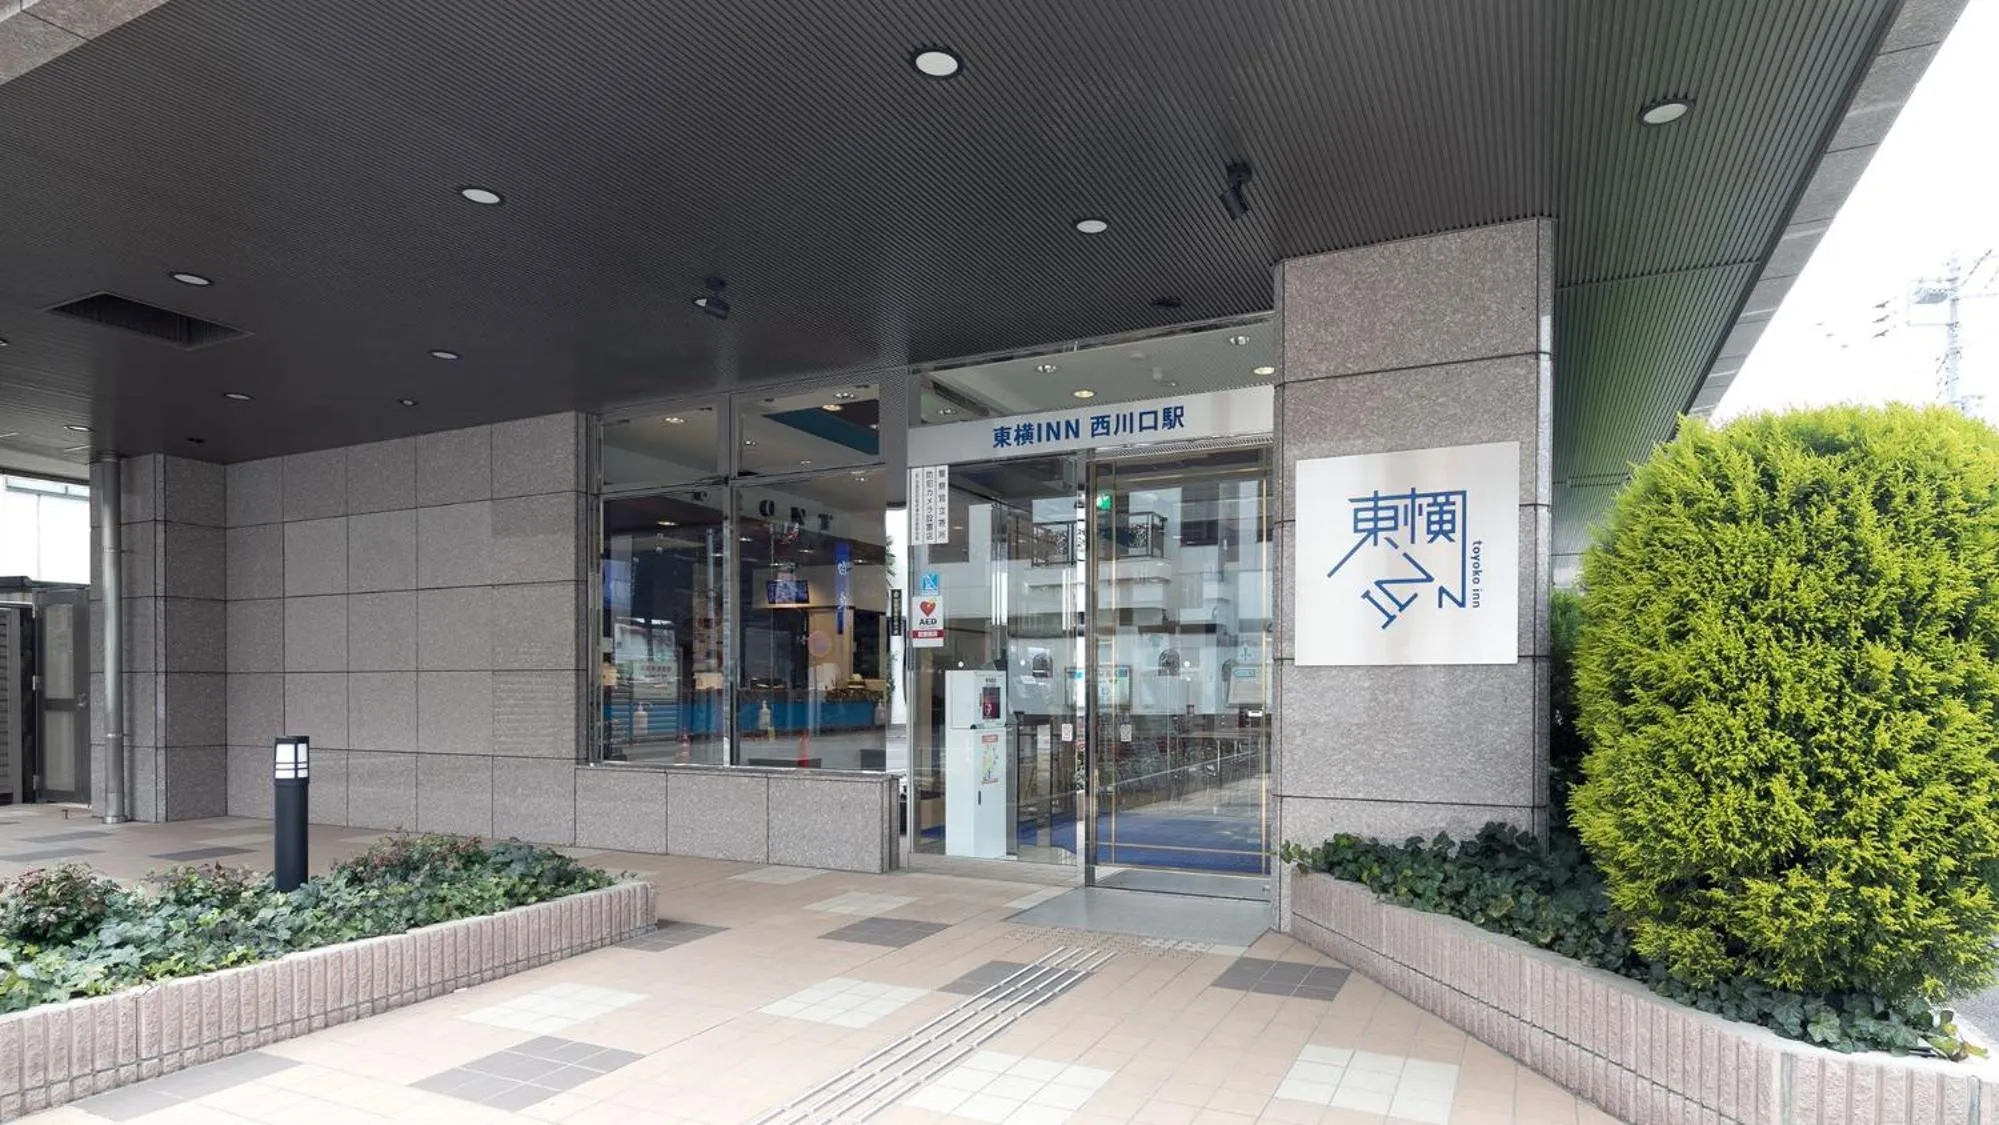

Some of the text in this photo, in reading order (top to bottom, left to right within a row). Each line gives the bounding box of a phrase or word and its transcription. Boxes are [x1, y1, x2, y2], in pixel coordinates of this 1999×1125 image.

[993, 405, 1185, 448] 東横INN 西川口駅
[1470, 540, 1484, 609] toyoko inn
[919, 618, 938, 626] AED
